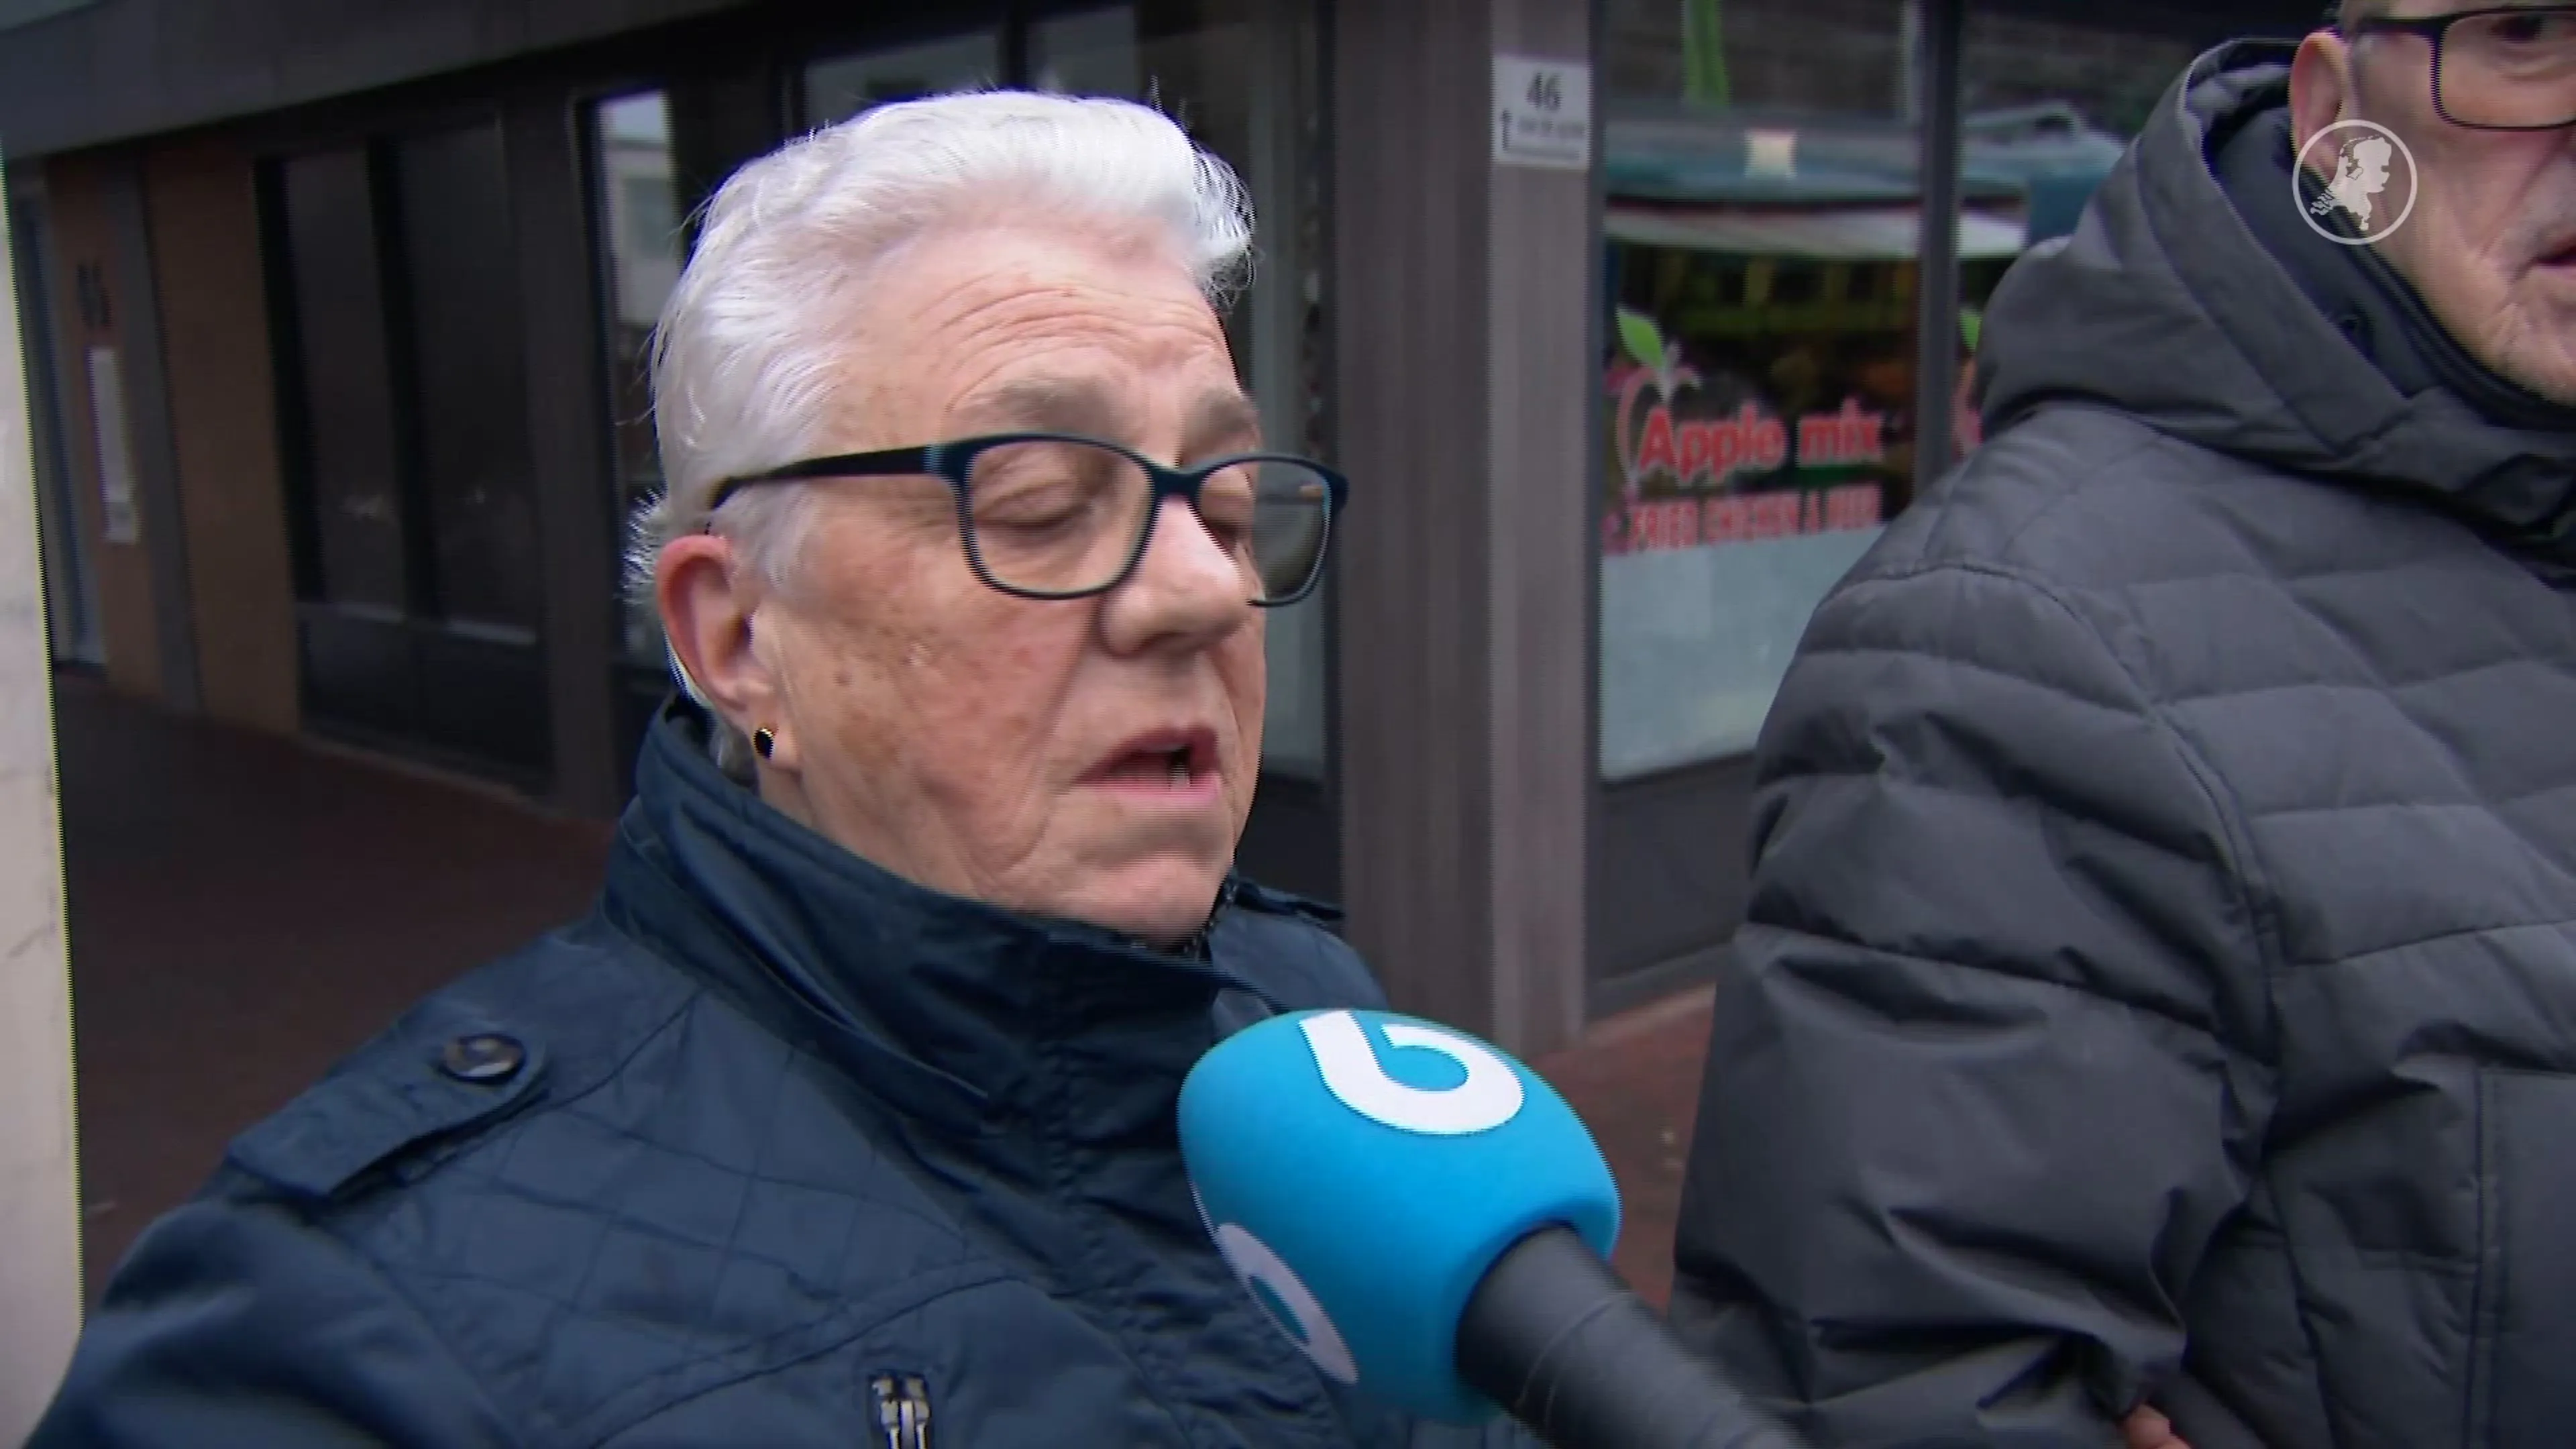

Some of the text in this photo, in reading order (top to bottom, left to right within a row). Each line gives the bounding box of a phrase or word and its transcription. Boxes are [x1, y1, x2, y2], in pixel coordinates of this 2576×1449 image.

[1526, 71, 1562, 111] 46
[1639, 396, 1882, 484] Apple mix
